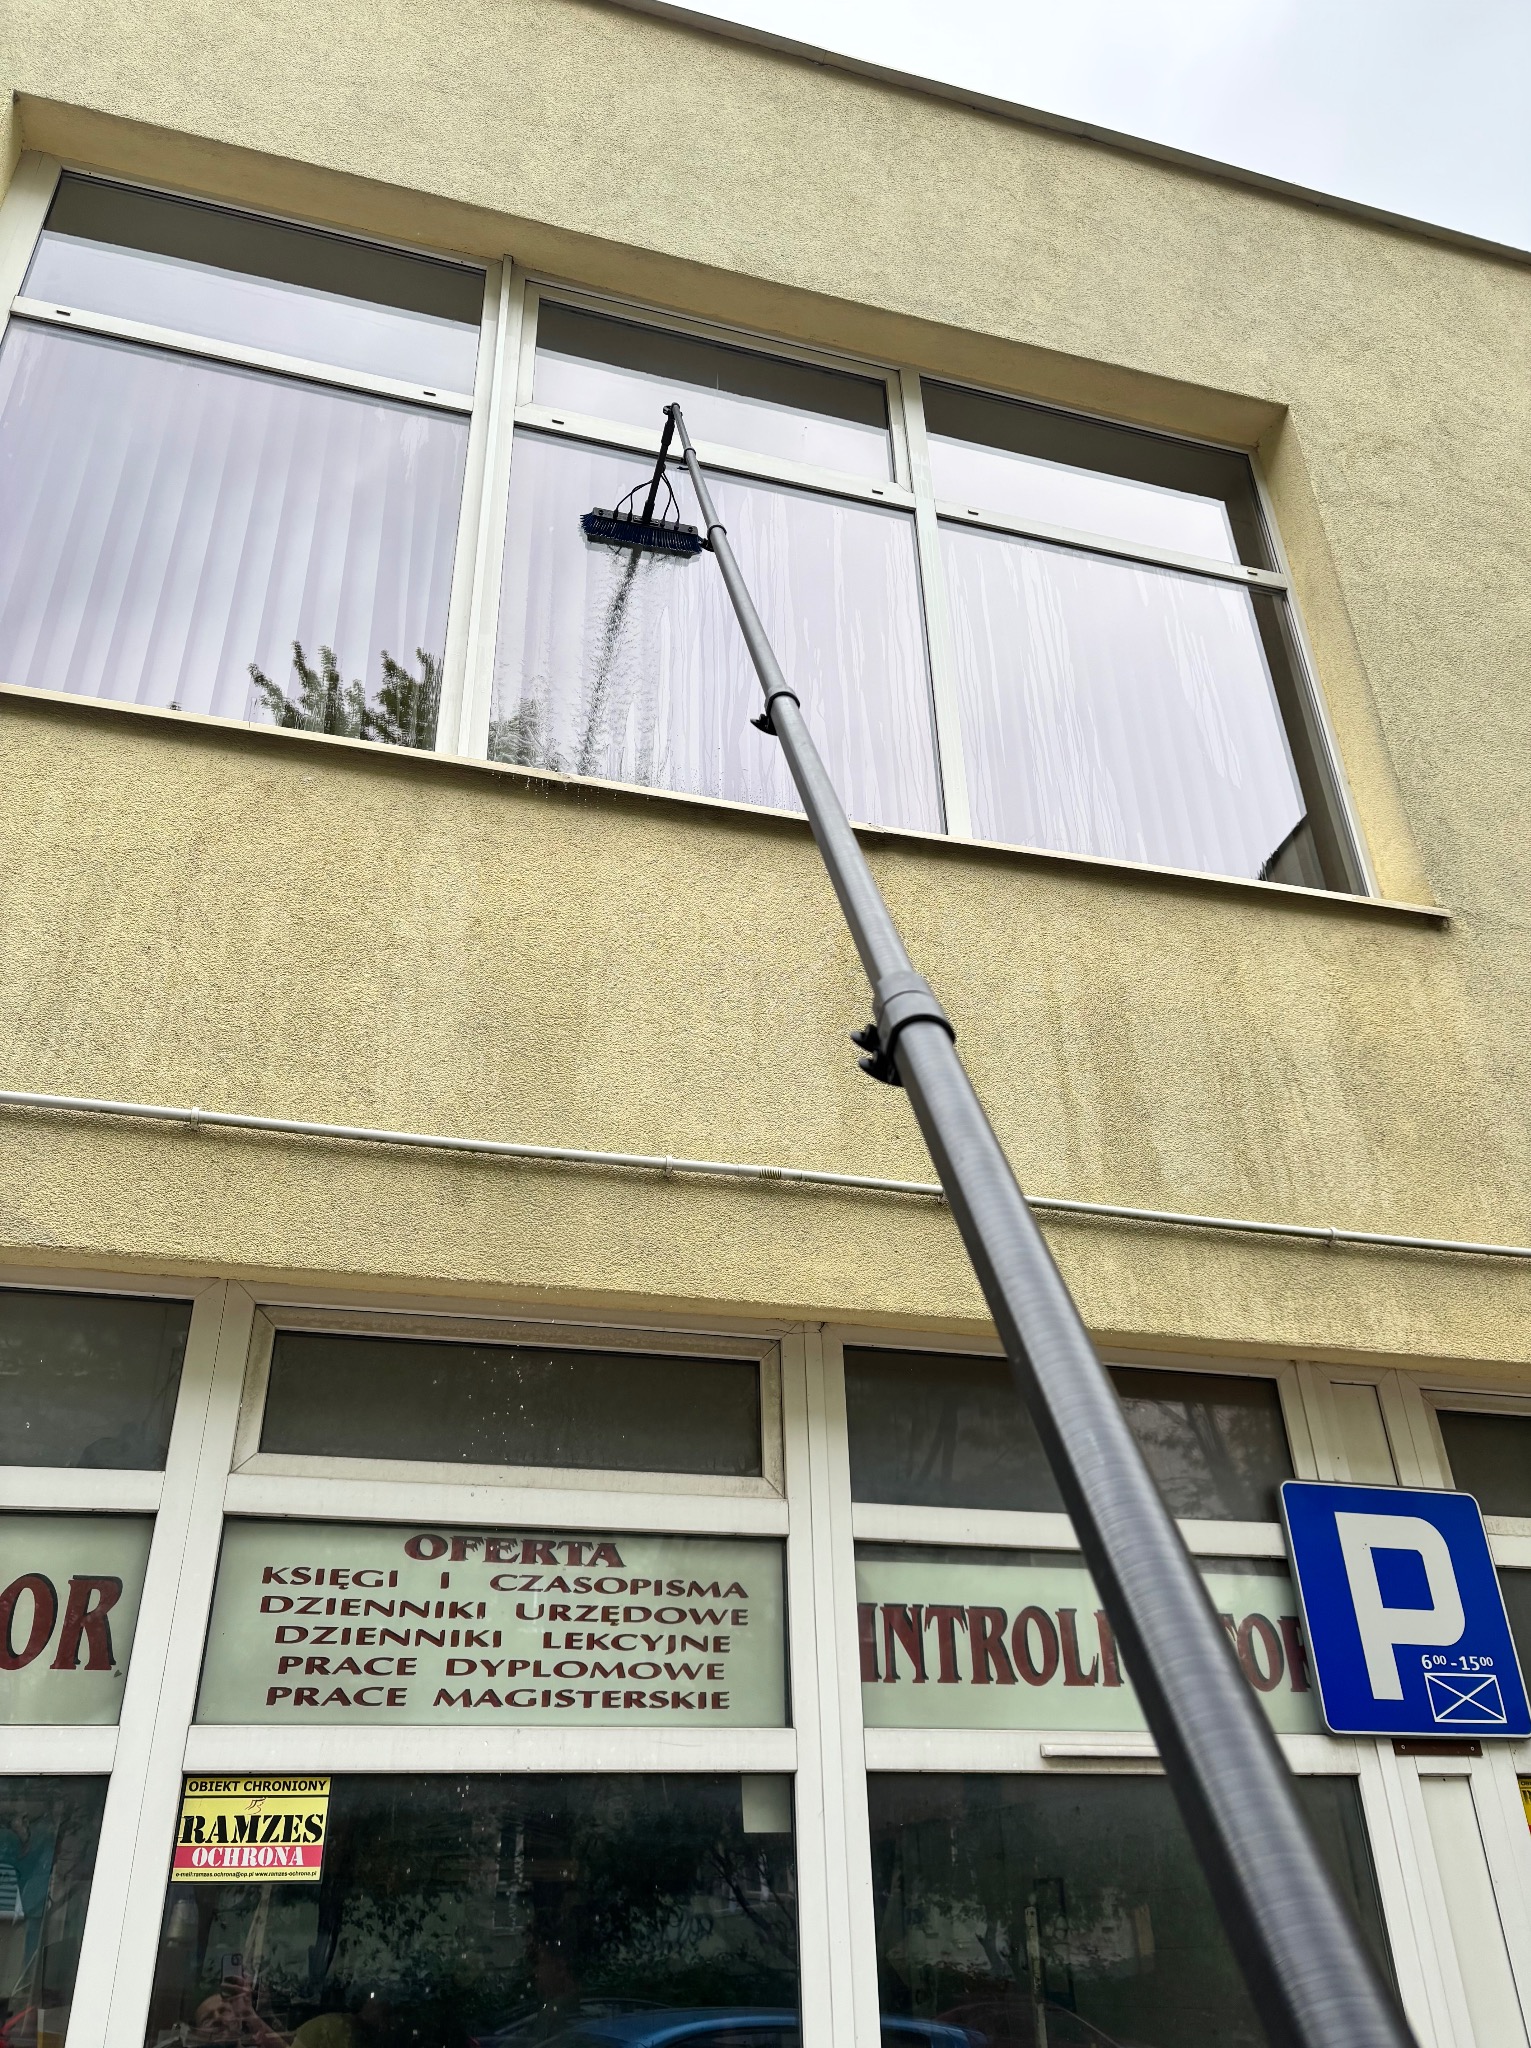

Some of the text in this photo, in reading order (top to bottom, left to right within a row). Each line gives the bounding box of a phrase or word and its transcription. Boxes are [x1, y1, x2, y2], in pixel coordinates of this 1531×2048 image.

[404, 1533, 627, 1568] OFERTA
[261, 1566, 750, 1599] KSIĘGI I CZASOPISMA
[260, 1595, 749, 1627] DZIENNIKI URZĘDOWE
[1334, 1510, 1466, 1701] P
[275, 1625, 731, 1656] DZIENNIKI LEKCYJNE
[277, 1655, 725, 1681] PRACE DYPLOMOWE
[265, 1686, 731, 1710] PRACE MAGISTERSKIE
[188, 1780, 327, 1792] OBIEKT CHRONIONY
[179, 1813, 324, 1844] RAMZES
[191, 1846, 305, 1867] OCHRONA
